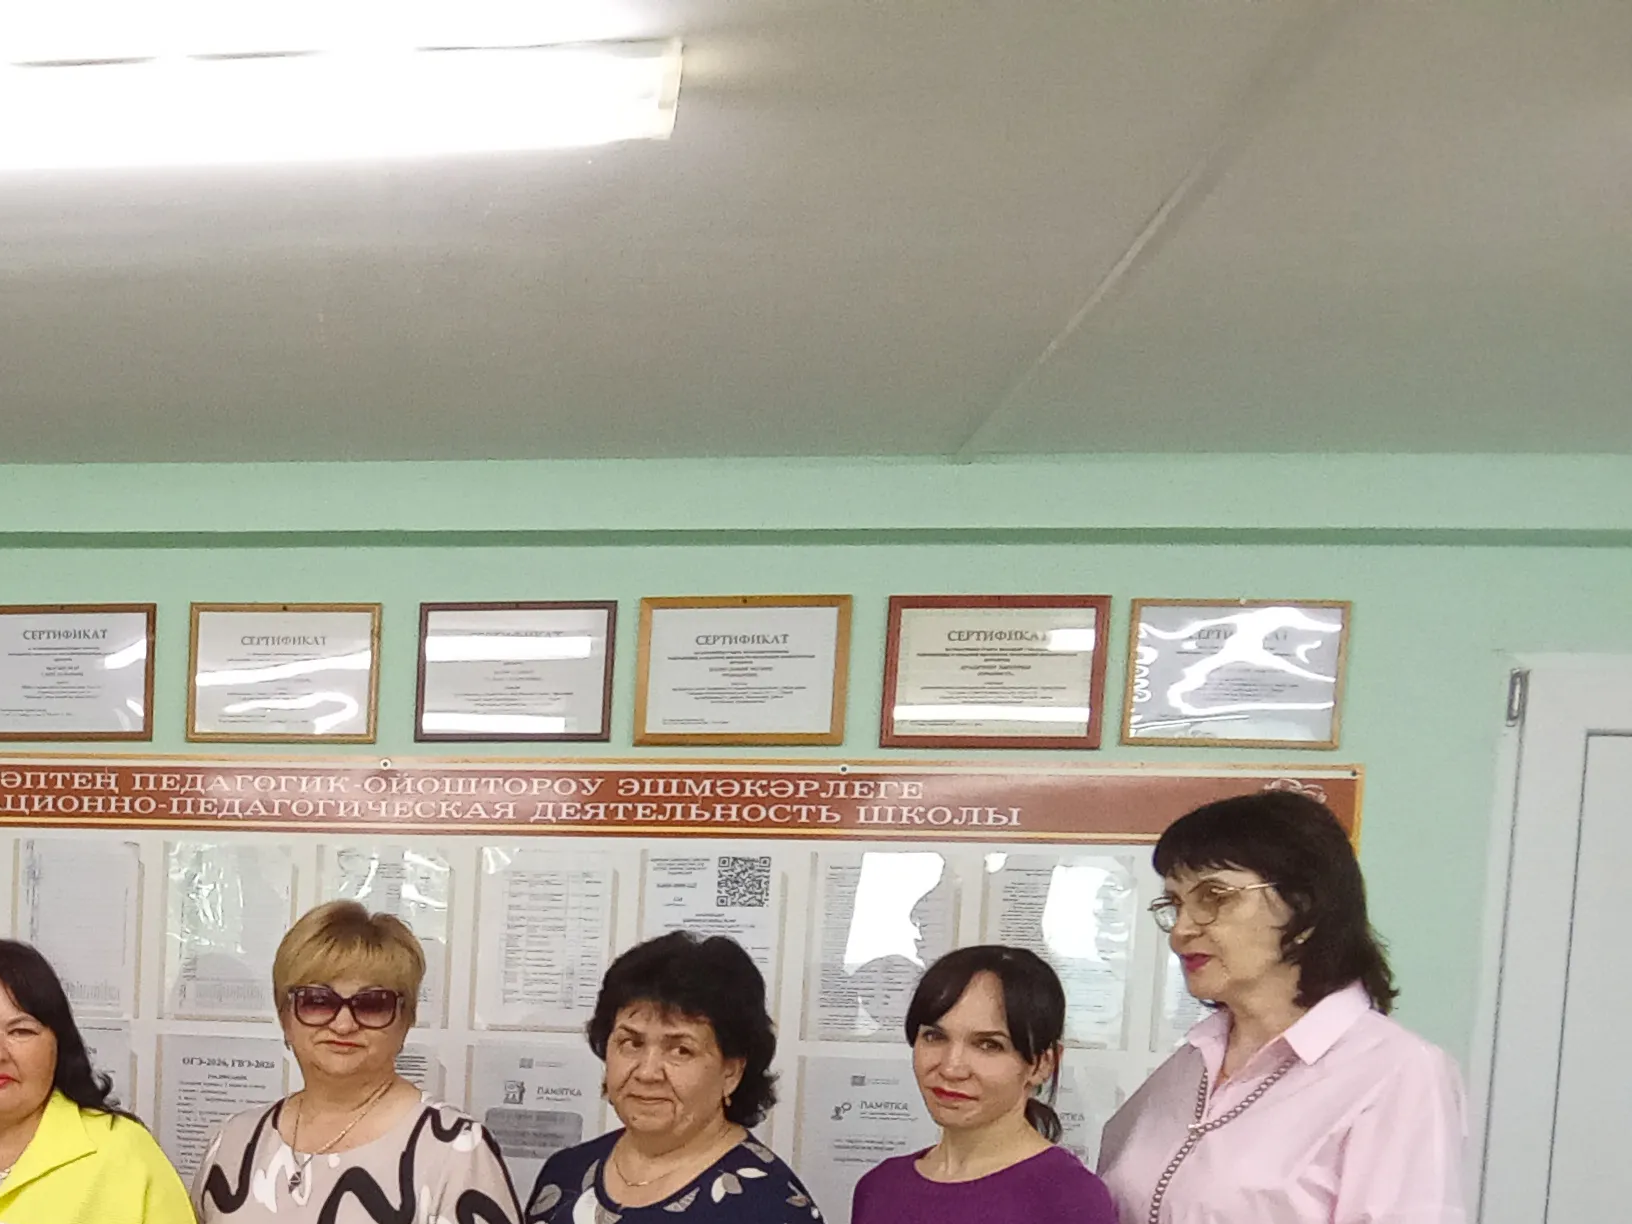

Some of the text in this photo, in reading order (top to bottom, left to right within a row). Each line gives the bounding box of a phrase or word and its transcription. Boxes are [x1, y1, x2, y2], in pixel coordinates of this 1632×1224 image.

[23, 629, 108, 640] СЕРТИФИКАТ
[695, 634, 790, 646] СЕРТИФИКАТ
[241, 636, 328, 646] СЕРТИФИКАТ
[617, 777, 923, 800] ЭШМӘКӘРЛЕГЕ
[530, 801, 841, 824] ДЕЯТЕЛЬНОСТЬ
[856, 804, 1021, 827] ШКОЛЫ
[536, 1086, 582, 1096] ПАМЯТКА
[860, 1101, 908, 1110] ПАМЯТКА
